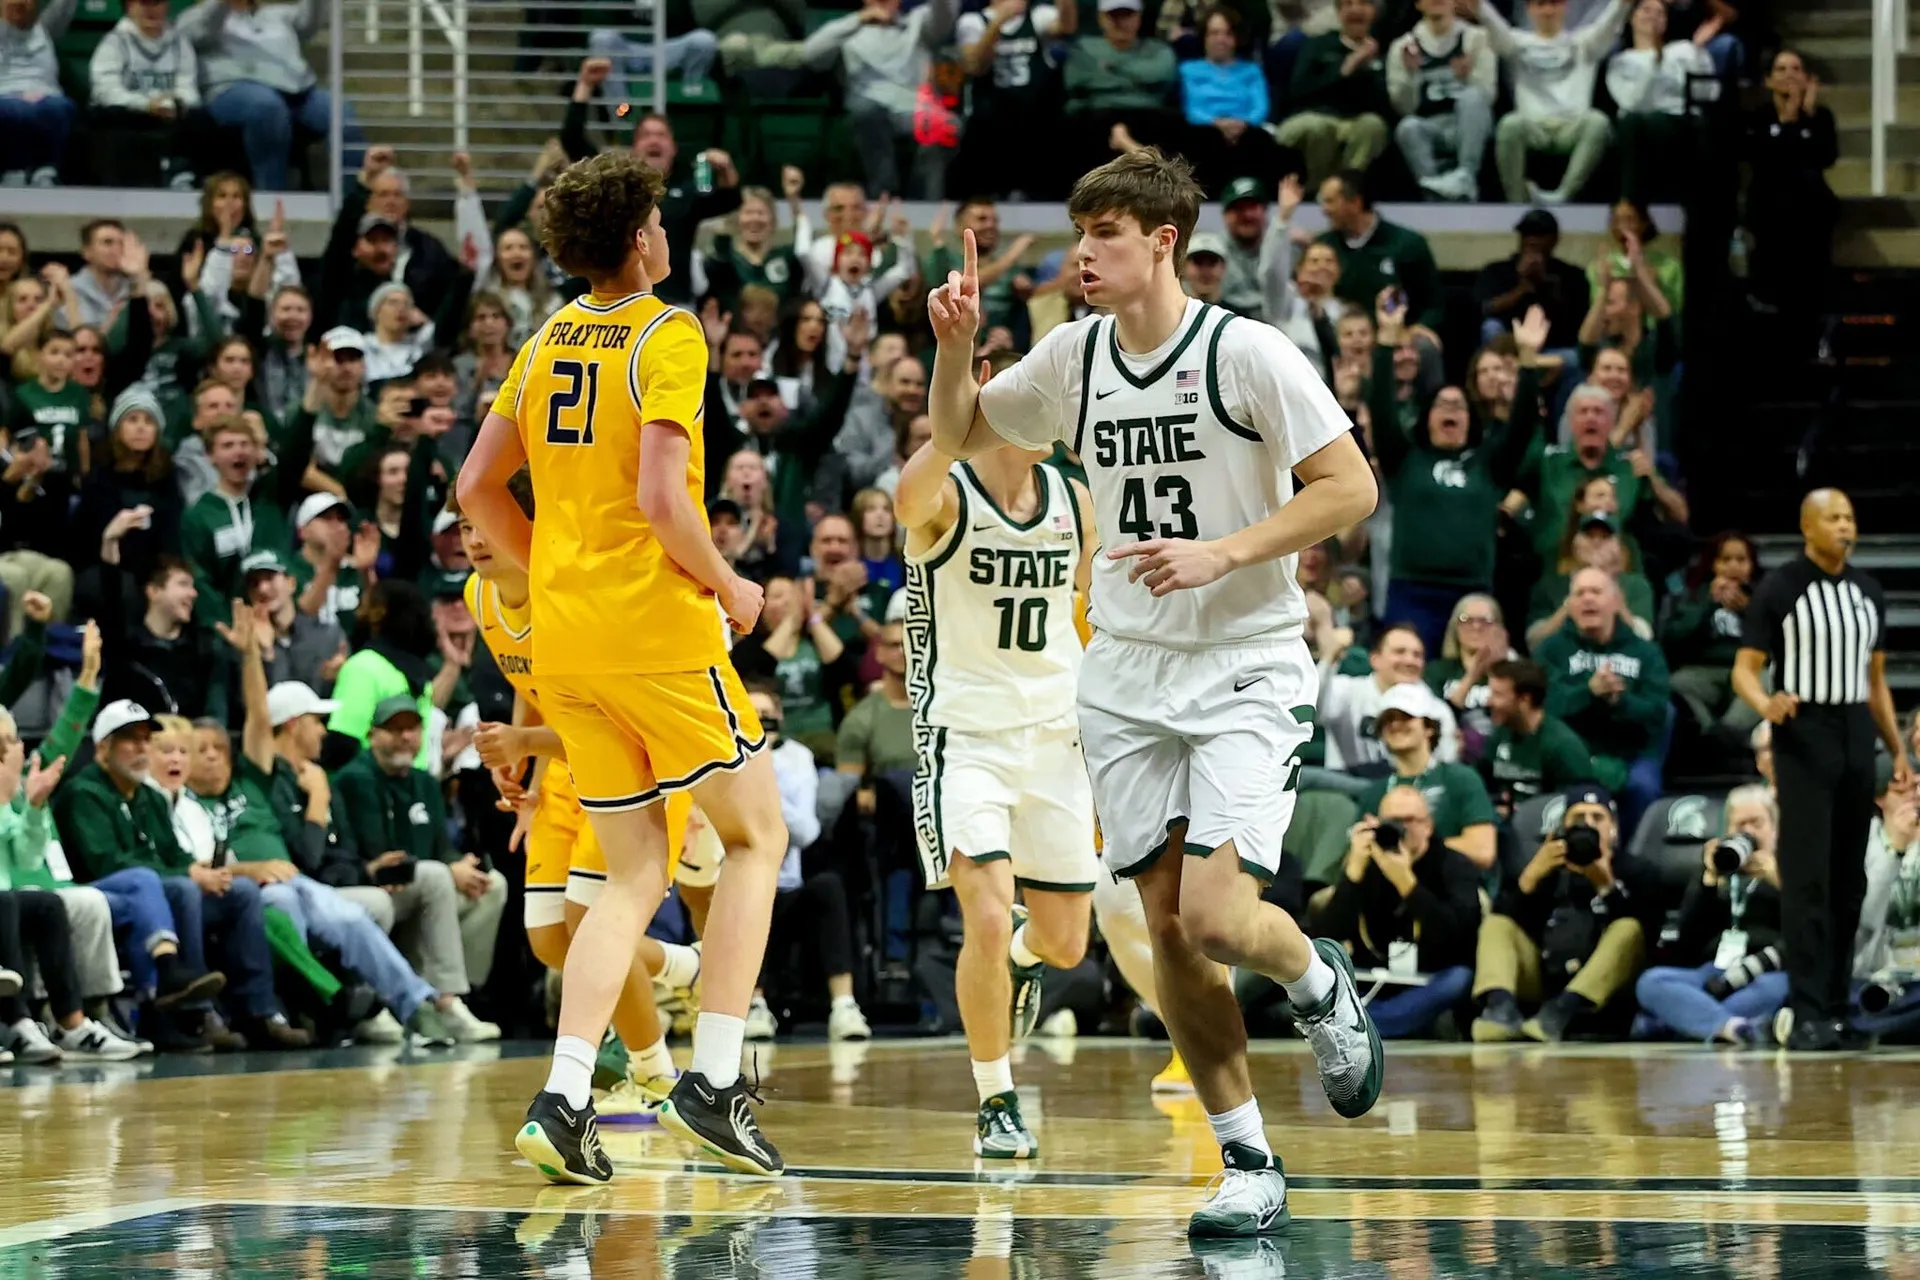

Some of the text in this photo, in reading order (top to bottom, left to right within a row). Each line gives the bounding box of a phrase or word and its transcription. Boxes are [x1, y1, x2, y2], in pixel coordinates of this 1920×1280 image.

[545, 321, 632, 350] PRAYTOR
[545, 358, 601, 446] 21
[1093, 413, 1207, 468] STATE
[1118, 474, 1200, 542] 43
[969, 547, 1071, 588] STATE
[993, 597, 1049, 652] 10
